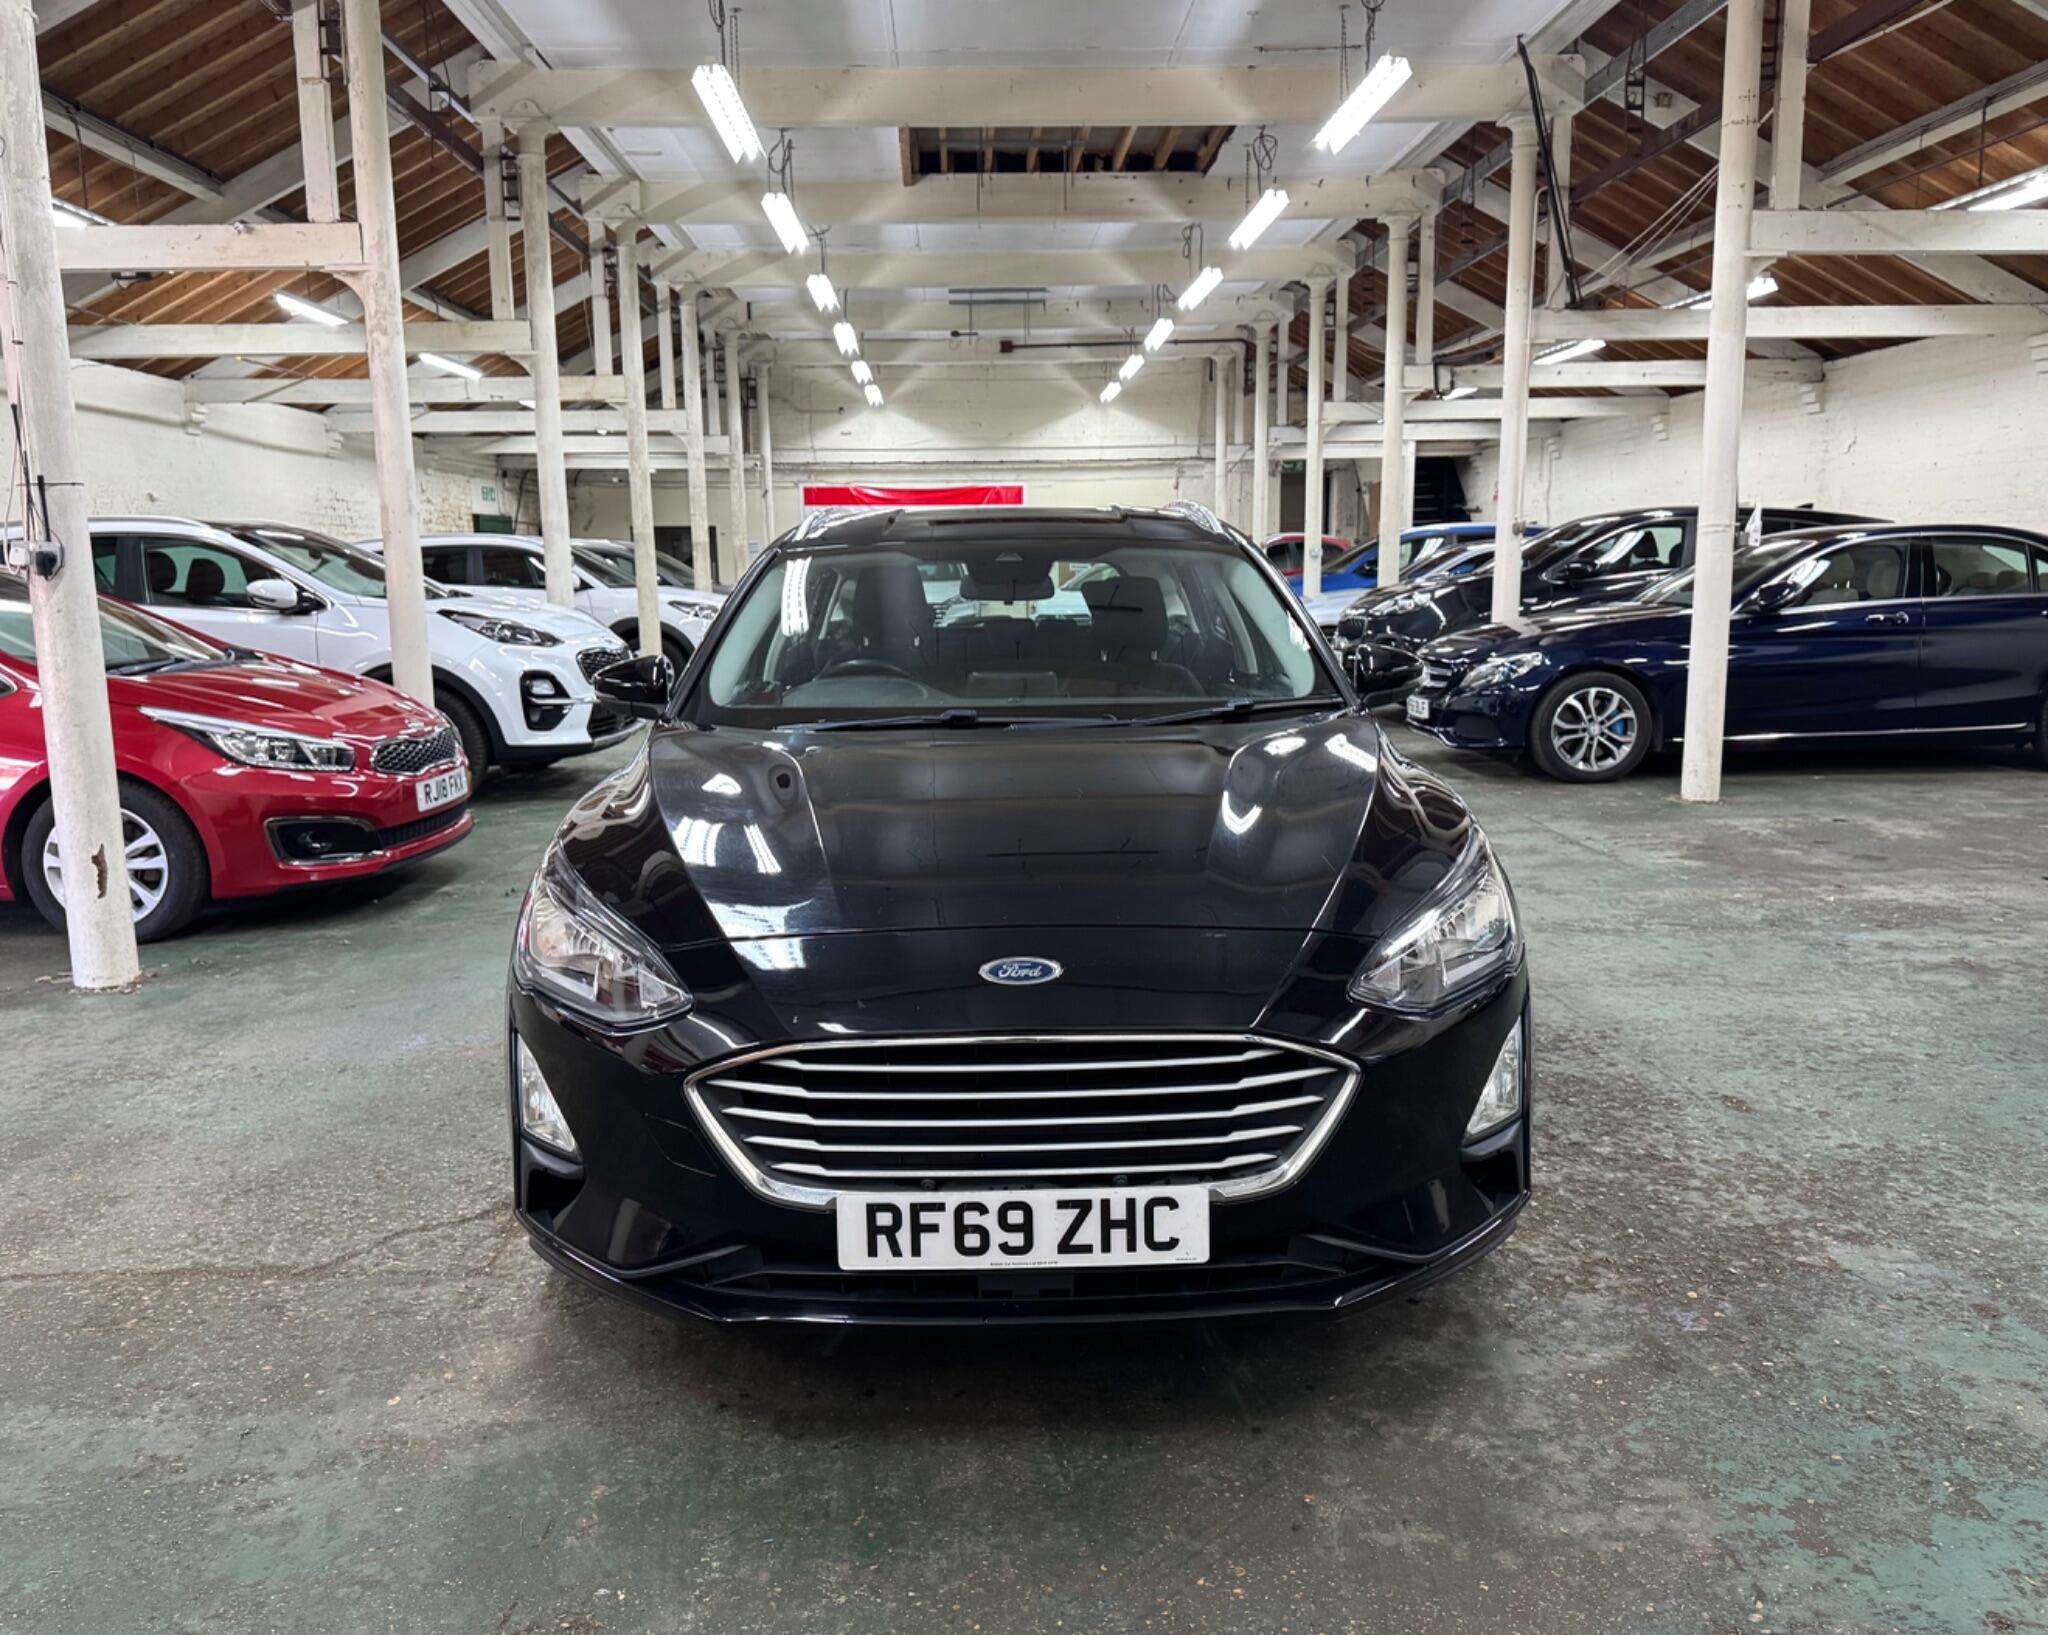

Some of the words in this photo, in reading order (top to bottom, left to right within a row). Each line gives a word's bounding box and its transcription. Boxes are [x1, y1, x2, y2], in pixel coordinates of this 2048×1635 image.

[423, 778, 448, 804] RJ18
[998, 962, 1042, 978] Ford
[865, 1200, 1034, 1258] RF69
[1056, 1196, 1181, 1255] ZHC
